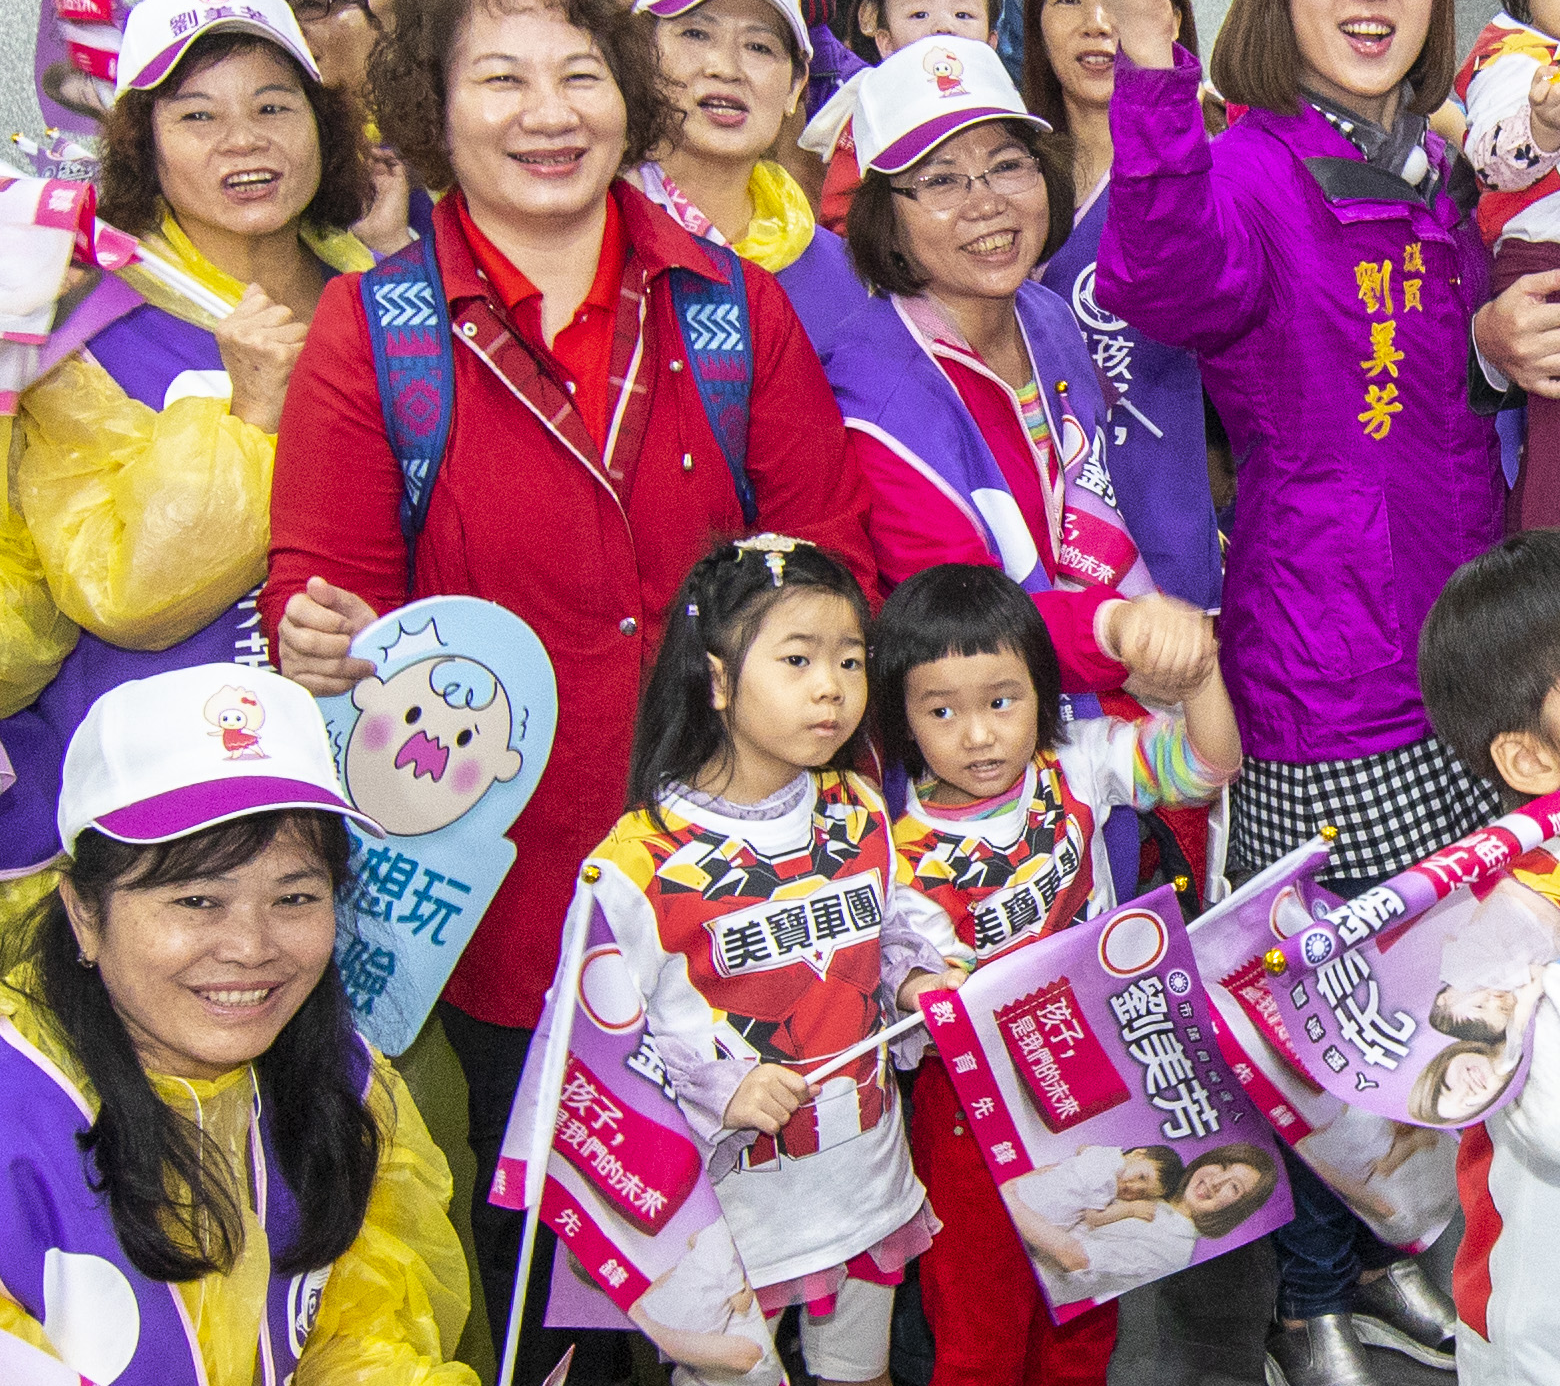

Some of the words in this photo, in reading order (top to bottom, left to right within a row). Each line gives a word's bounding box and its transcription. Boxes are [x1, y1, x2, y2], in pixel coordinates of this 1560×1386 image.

[1402, 243, 1426, 313] 議員
[1355, 260, 1403, 441] 劉美芳
[348, 839, 473, 947] 想玩
[721, 884, 882, 968] 美寶軍團
[931, 997, 1019, 1165] 教育先鋒
[1007, 1008, 1081, 1121] 是我們的未來
[1036, 997, 1085, 1059] 孩子，
[1109, 976, 1219, 1141] 劉美芳
